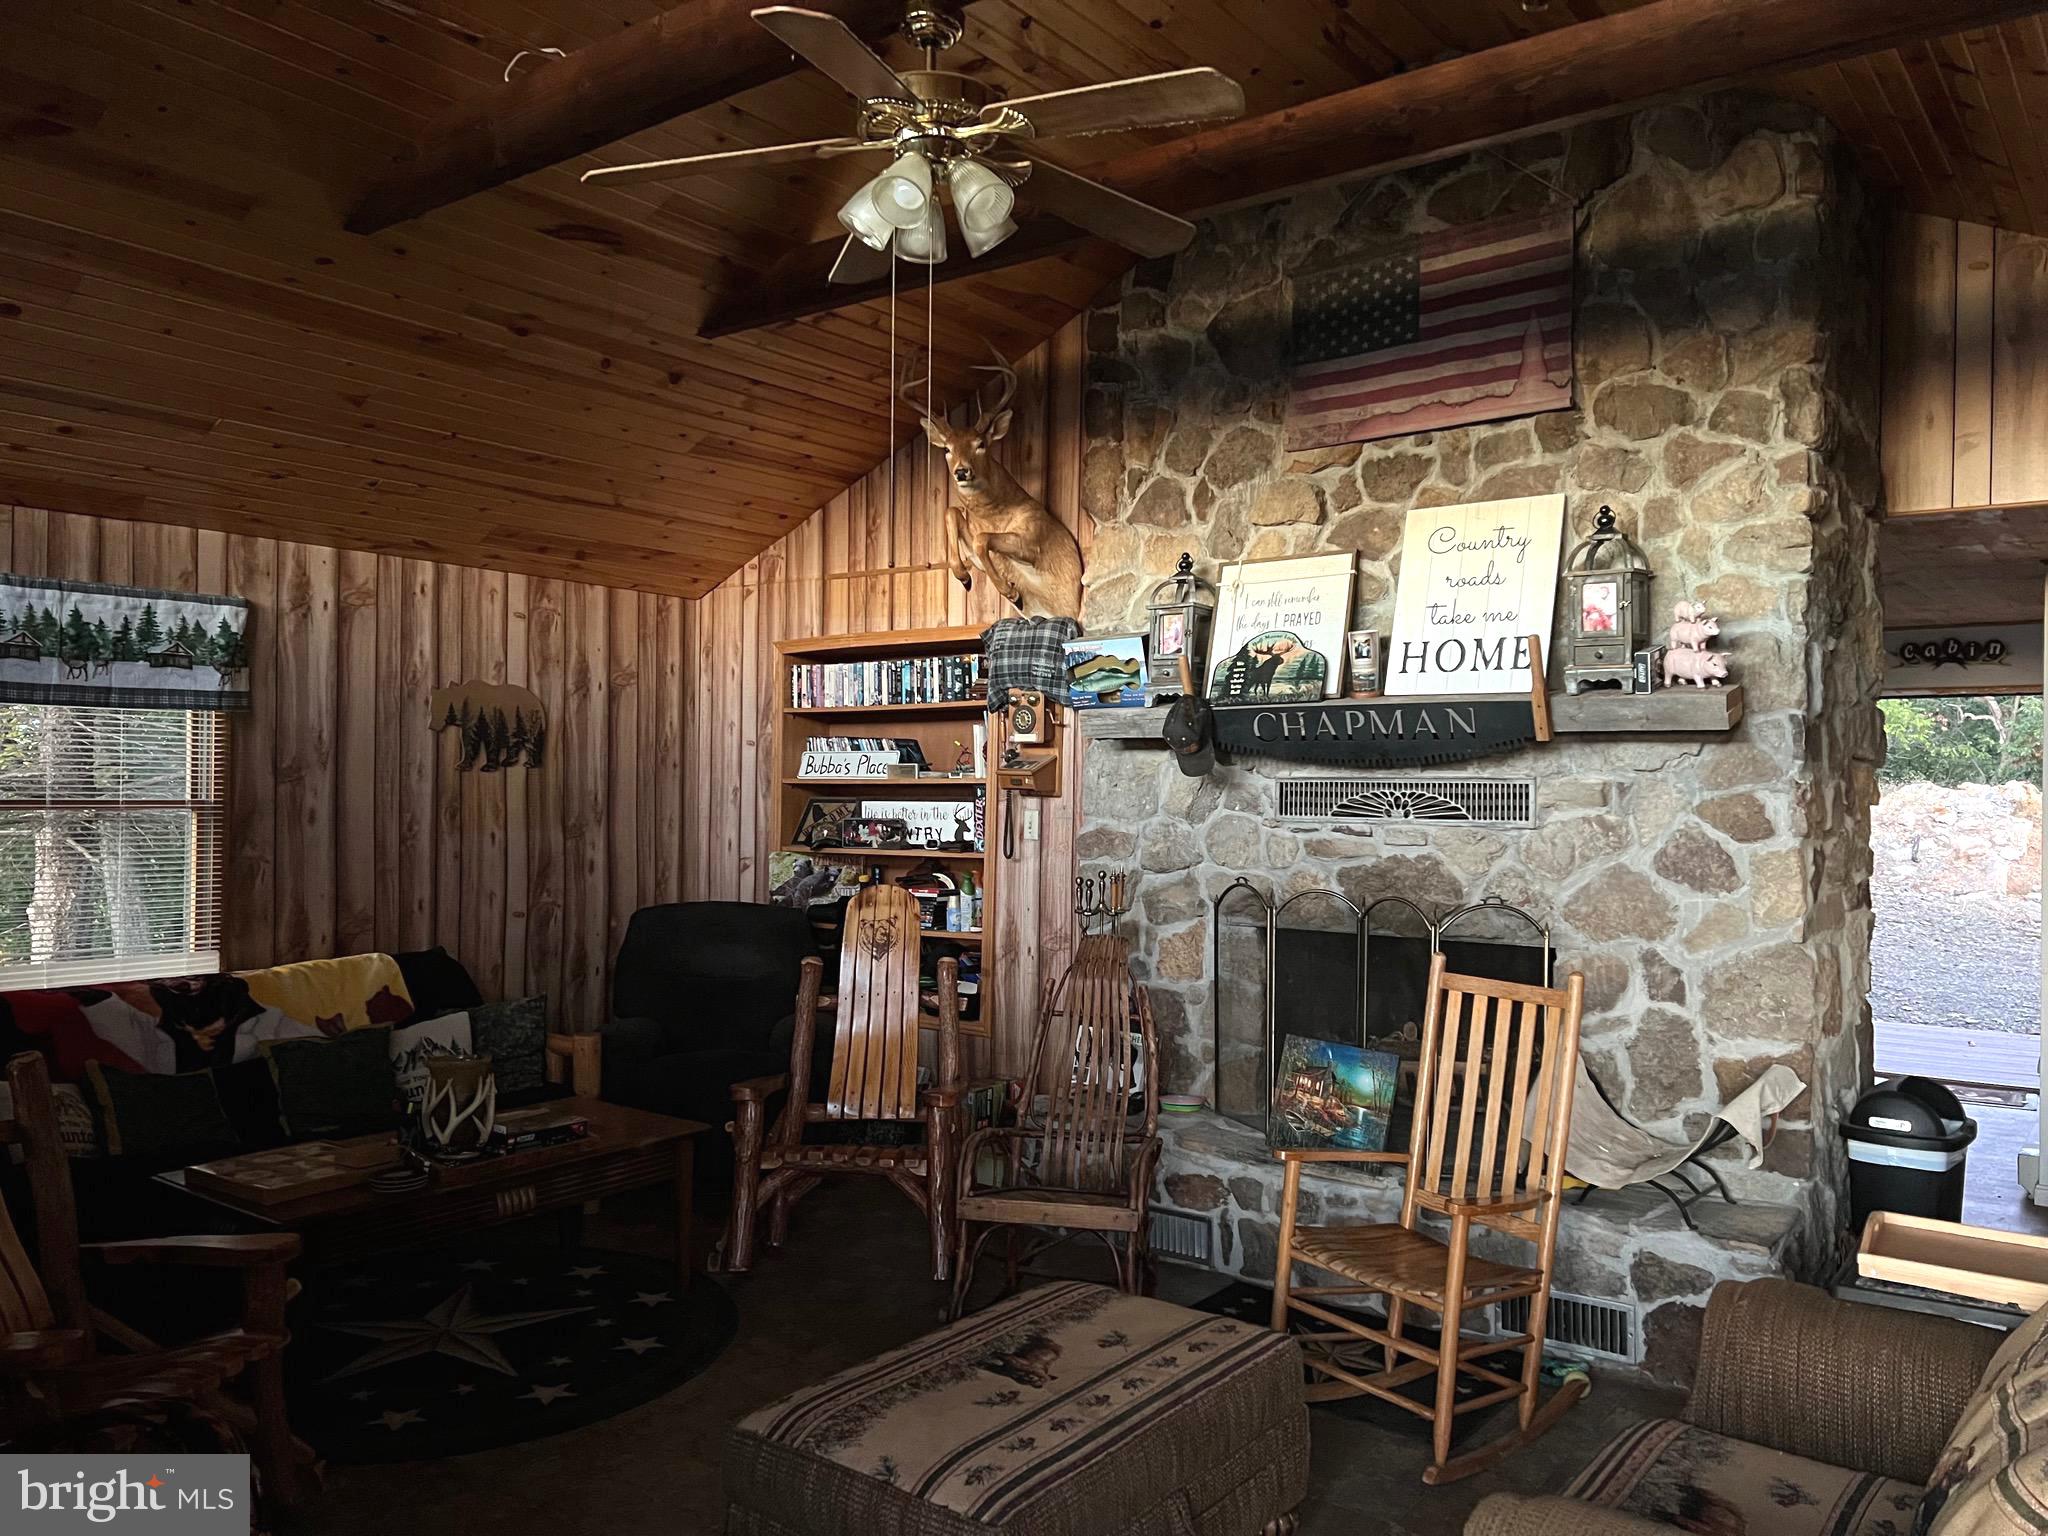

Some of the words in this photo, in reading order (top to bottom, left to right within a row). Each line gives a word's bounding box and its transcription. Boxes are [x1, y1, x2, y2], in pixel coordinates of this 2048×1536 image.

[1428, 525, 1532, 563] Country
[1445, 560, 1506, 587] roads
[1250, 613, 1270, 633] days
[1283, 611, 1322, 628] PRAYED
[1426, 599, 1476, 625] take
[1482, 609, 1518, 624] me
[1398, 636, 1531, 674] HOME
[1253, 706, 1477, 742] CHAPMAN
[804, 755, 851, 776] Bubba's
[856, 754, 888, 775] Place
[975, 798, 984, 839] DEXTER
[905, 827, 943, 841] NTRY
